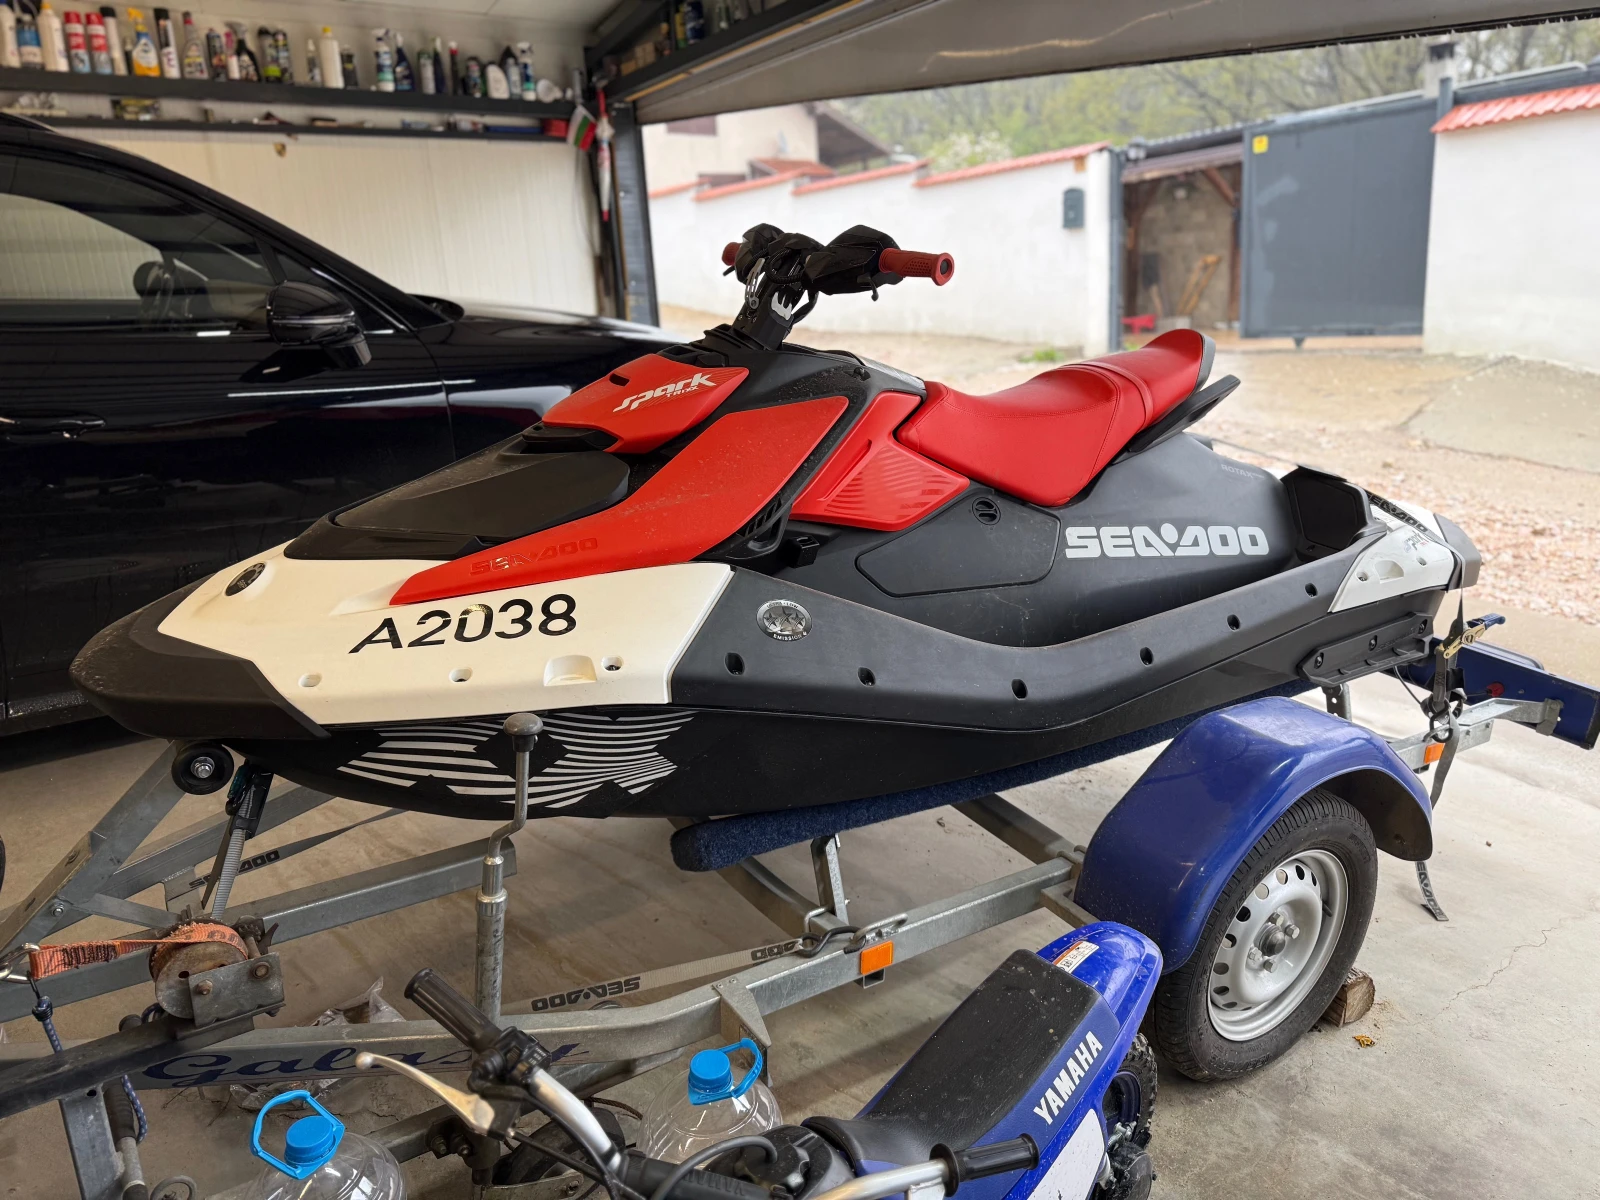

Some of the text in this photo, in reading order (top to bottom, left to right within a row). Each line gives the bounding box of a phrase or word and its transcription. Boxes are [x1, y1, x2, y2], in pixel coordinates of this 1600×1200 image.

[1220, 463, 1254, 479] ROTAX
[348, 593, 577, 654] A2038
[1032, 1031, 1104, 1125] YAMAHA
